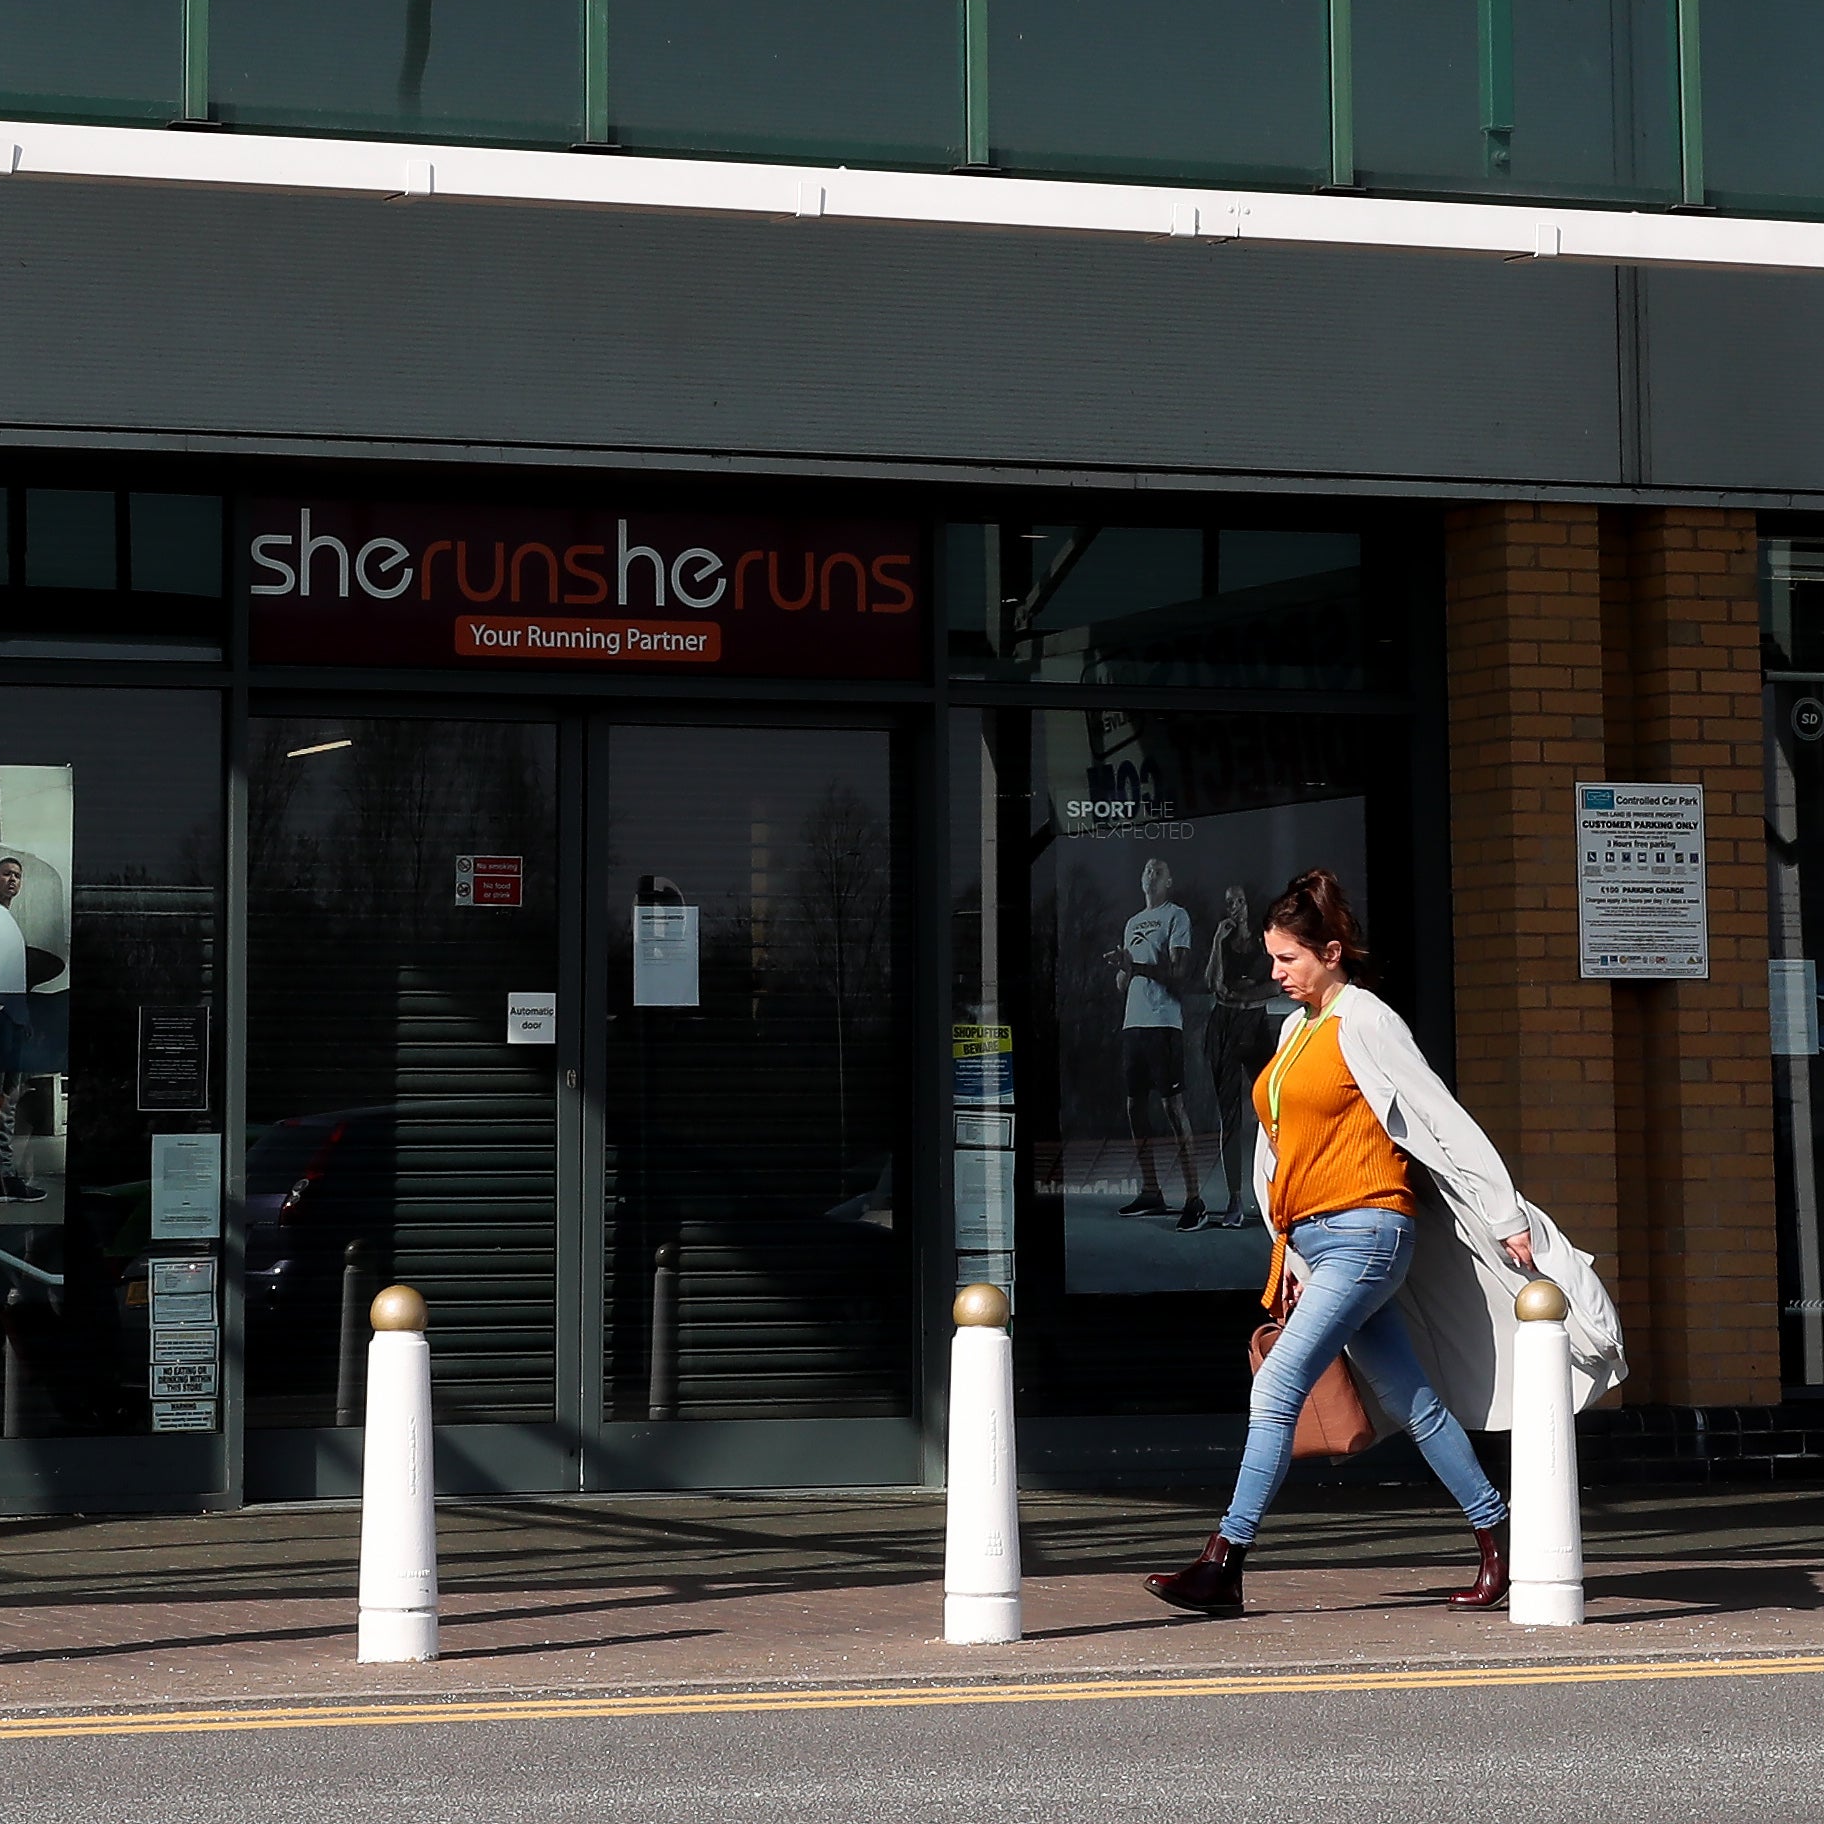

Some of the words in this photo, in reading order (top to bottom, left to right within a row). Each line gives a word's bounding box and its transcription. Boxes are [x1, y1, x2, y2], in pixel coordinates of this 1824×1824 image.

[469, 624, 522, 649] Your
[528, 626, 620, 656] Running
[626, 629, 708, 653] Partner
[1616, 796, 1660, 805] Controlled
[1662, 796, 1676, 805] Car
[1679, 797, 1698, 806] Park
[1066, 800, 1136, 818] SPORT
[1138, 801, 1174, 818] THE
[1067, 821, 1194, 840] UNEXPECTED
[1582, 820, 1632, 829] CUSTOMER
[1634, 821, 1673, 829] PARKING
[1675, 821, 1698, 830] ONLY
[1613, 840, 1632, 848] Hours
[1634, 840, 1648, 848] free
[1650, 841, 1675, 849] parking
[510, 1006, 554, 1016] Automatic
[522, 1020, 542, 1030] door
[953, 1027, 1010, 1039] SHOPLIFTERS
[963, 1041, 1000, 1055] BEWARE
